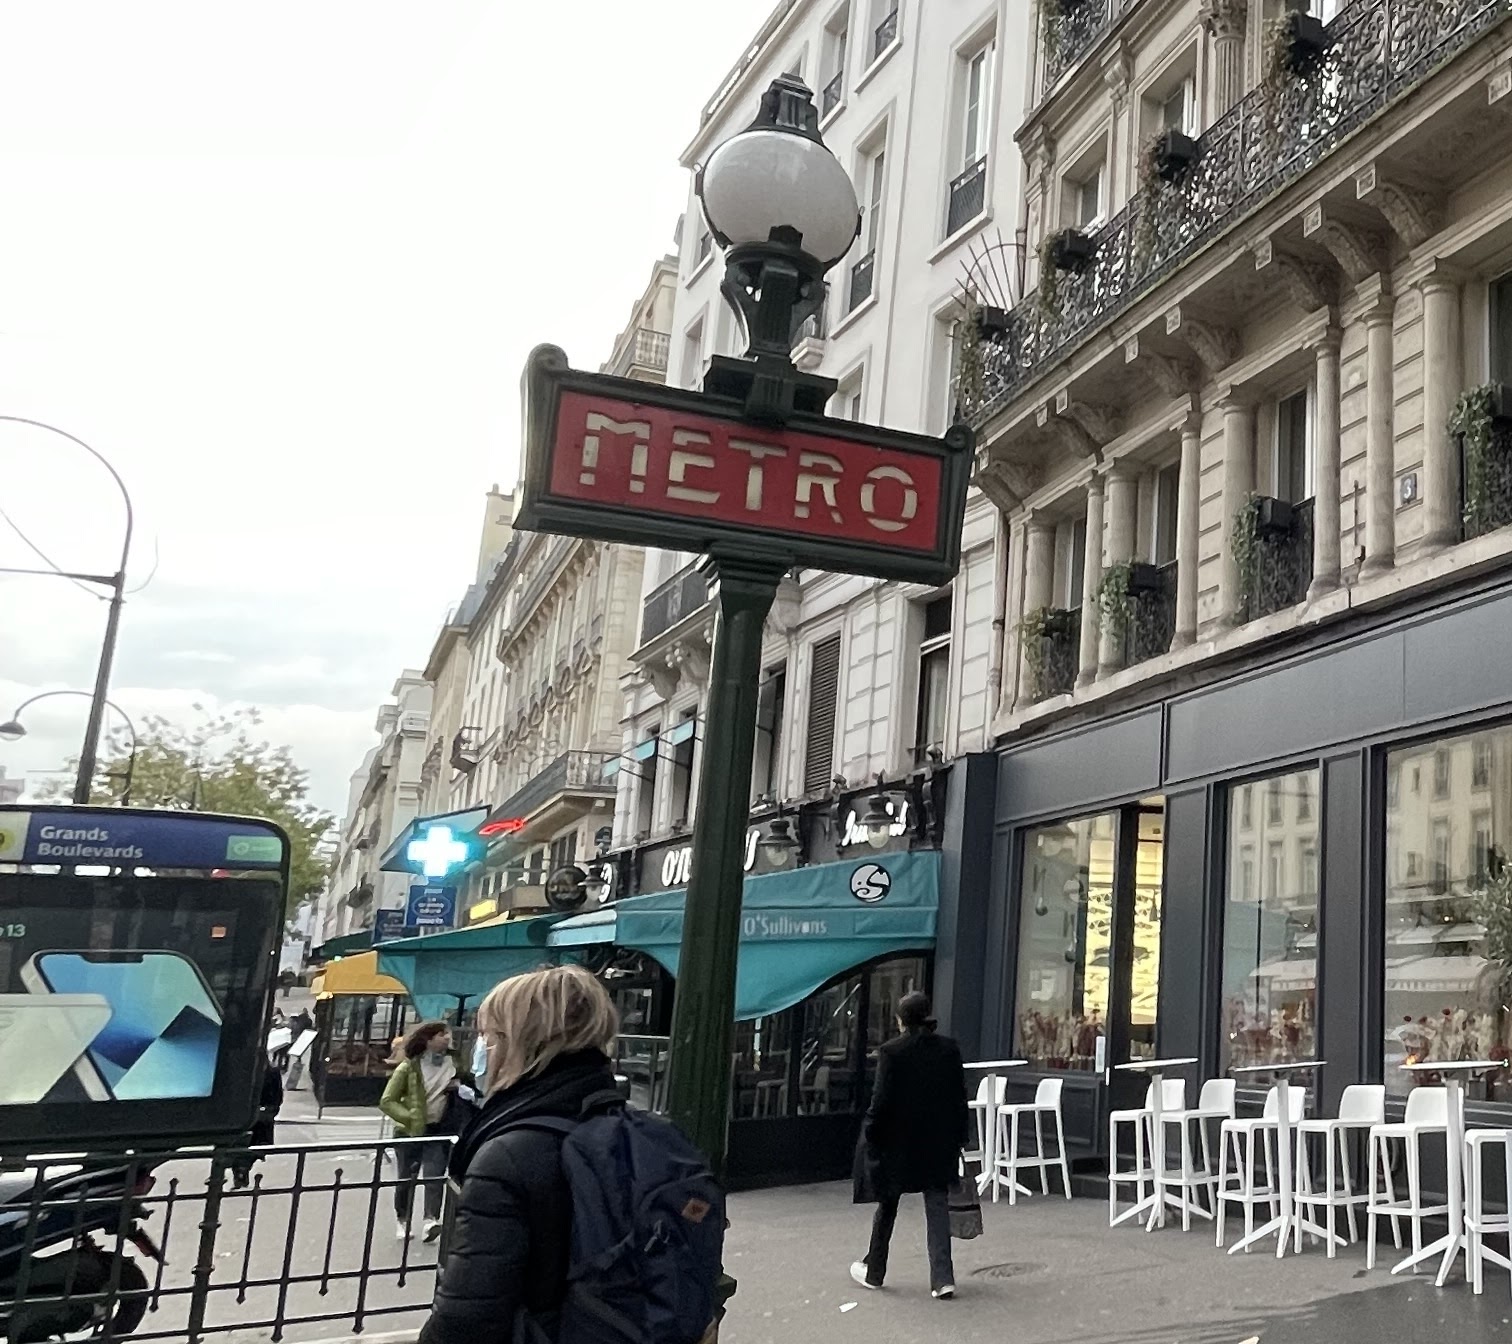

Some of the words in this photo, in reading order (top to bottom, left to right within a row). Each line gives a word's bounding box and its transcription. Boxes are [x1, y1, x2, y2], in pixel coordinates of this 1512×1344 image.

[579, 411, 918, 532] METRO
[40, 825, 109, 841] Grands
[37, 842, 143, 859] Boulevards
[7, 923, 26, 937] 13
